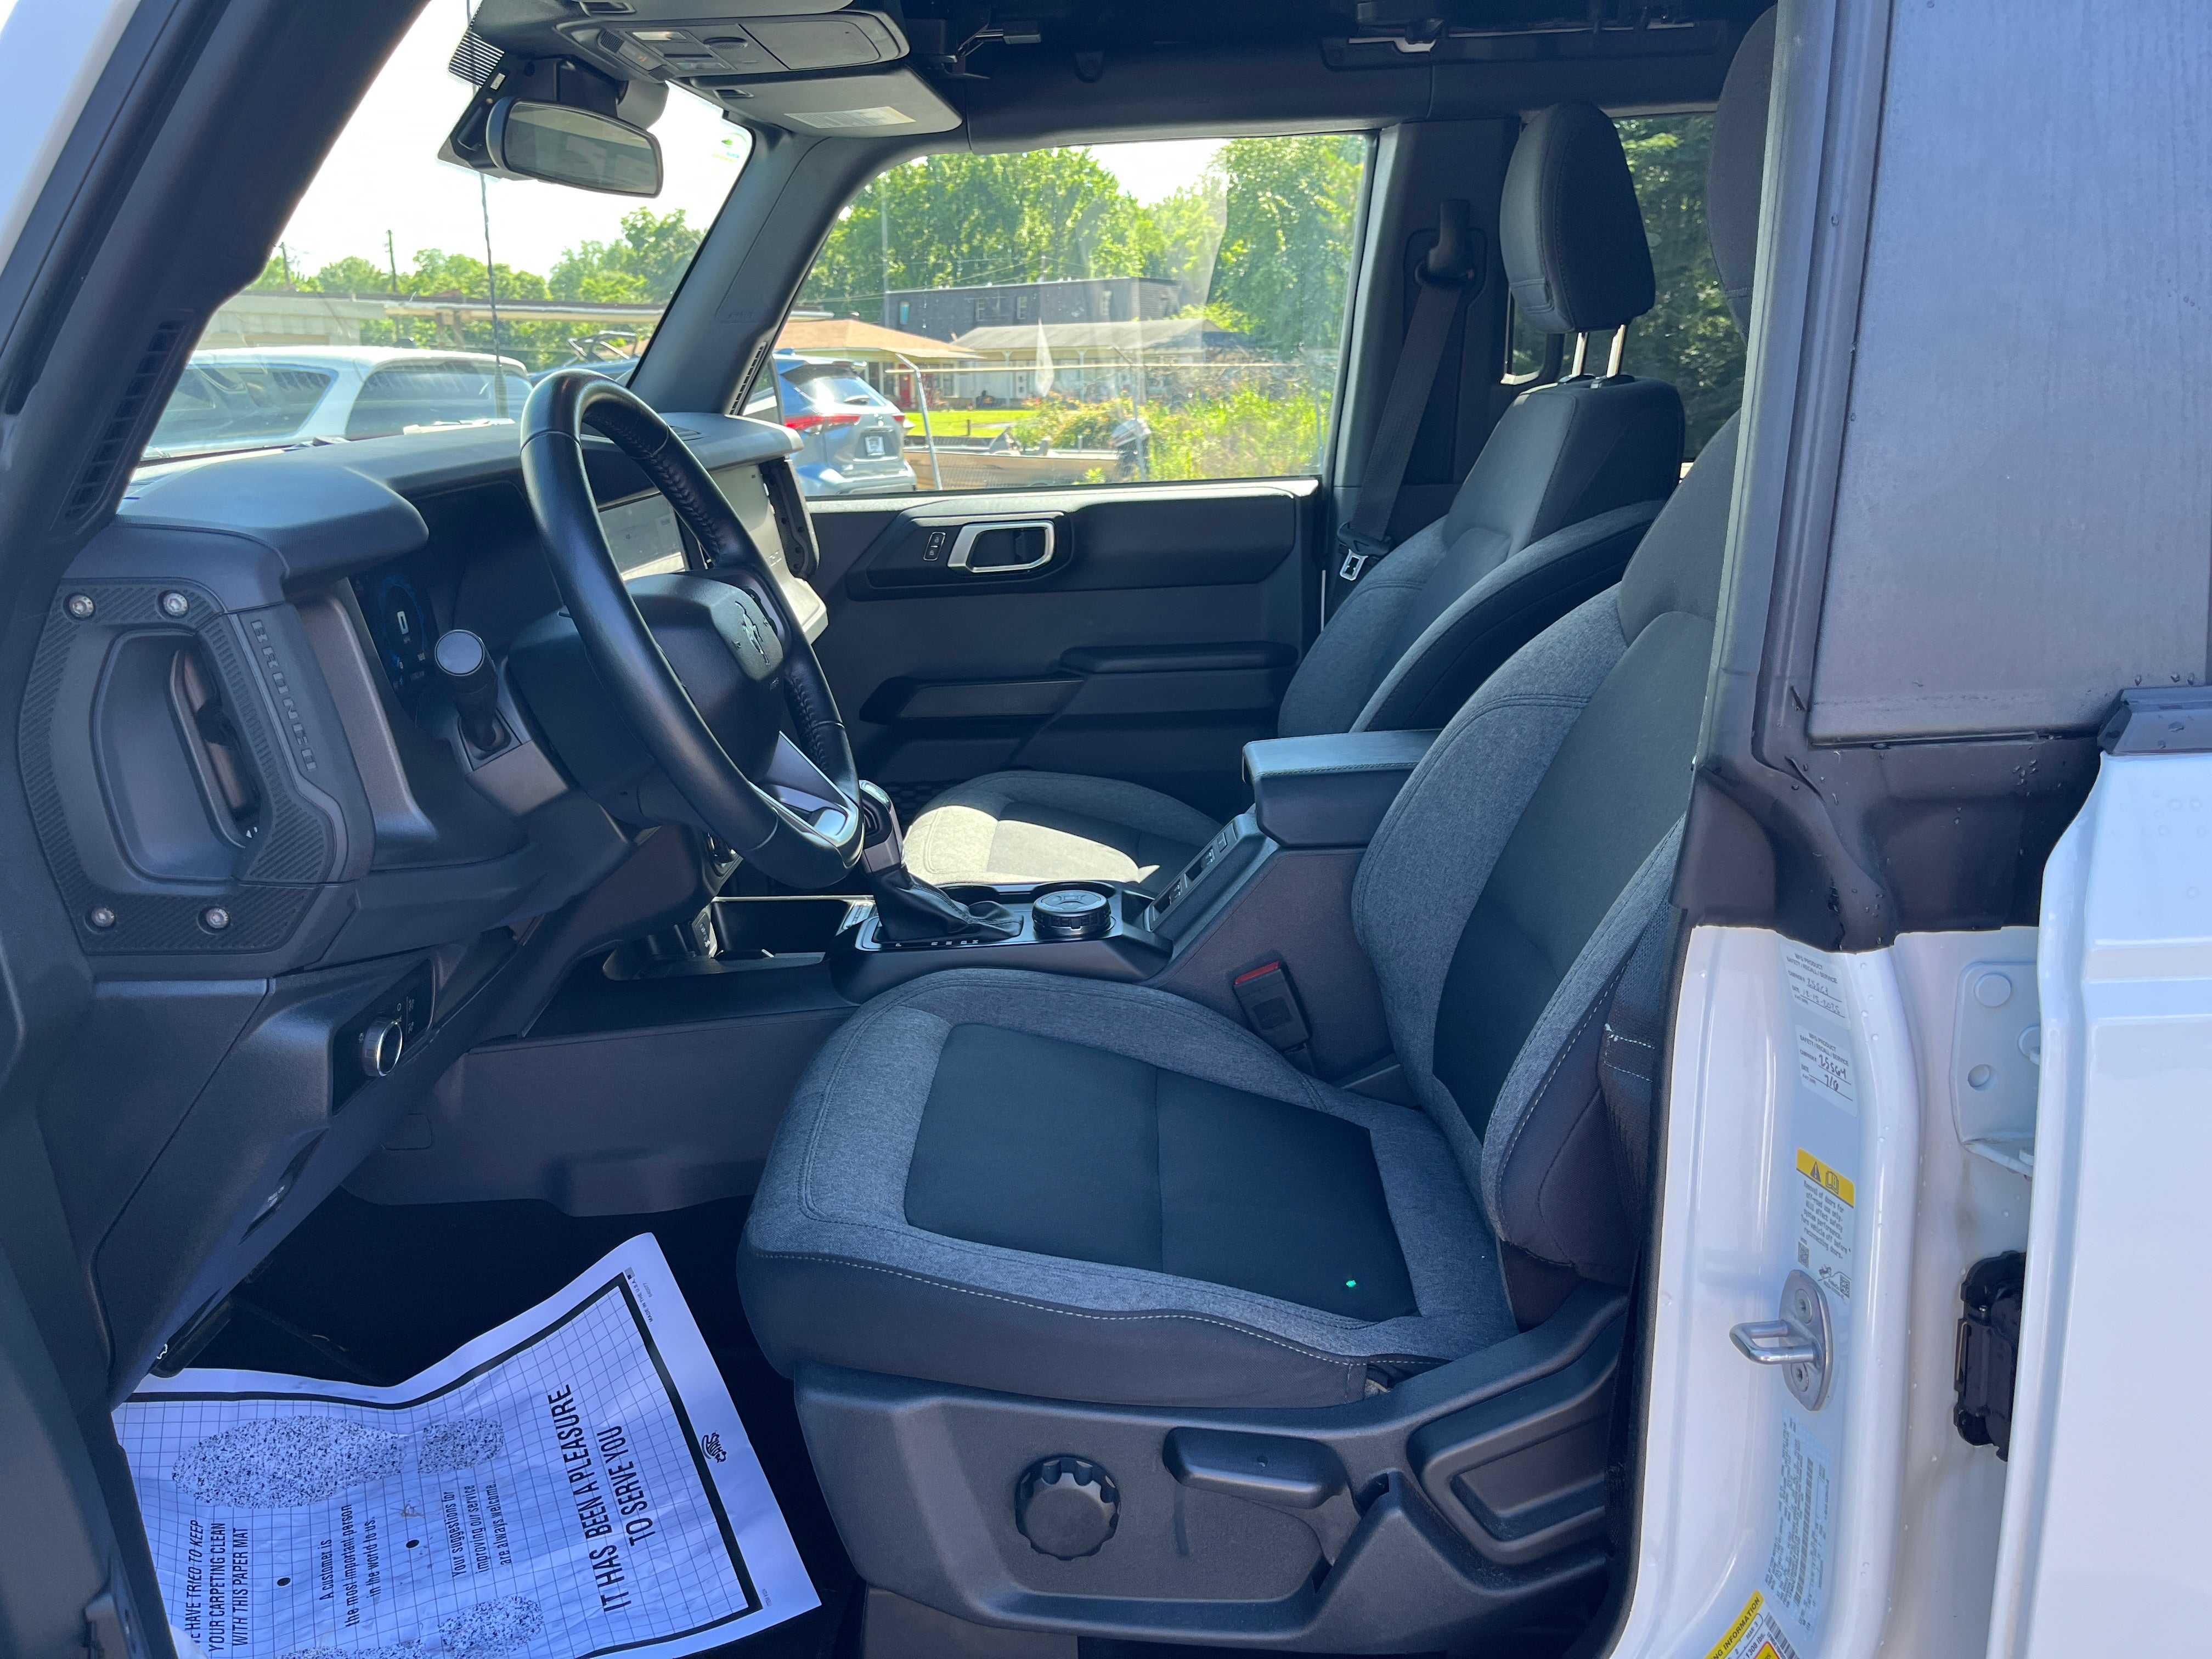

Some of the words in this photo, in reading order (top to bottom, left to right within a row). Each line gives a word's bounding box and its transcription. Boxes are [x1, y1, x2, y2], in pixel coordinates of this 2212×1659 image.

[251, 620, 317, 772] BRONCO
[1786, 956, 1800, 966] SAFETY
[1803, 963, 1818, 975] RECALL
[1820, 972, 1838, 984] SERVICE
[1804, 957, 1822, 970] PRODUCT
[1799, 1035, 1814, 1046] SAFETY
[1816, 1043, 1830, 1056] RECALL
[1832, 1053, 1849, 1066] SERVICE
[1818, 1037, 1836, 1052] PRODUCT
[1825, 1195, 1836, 1208] doors
[1810, 1223, 1825, 1237] vehicle
[1834, 1239, 1847, 1254] before
[1830, 1218, 1843, 1233] safety
[645, 1307, 653, 1322] MADE
[548, 1384, 597, 1483] PLEASURE
[597, 1426, 629, 1464] YOU
[442, 1492, 455, 1502] for
[462, 1485, 479, 1513] service
[486, 1481, 501, 1519] welcome.
[573, 1480, 600, 1496] A
[608, 1460, 648, 1516] SERVE
[341, 1505, 357, 1536] person
[364, 1517, 376, 1532] us.
[444, 1503, 465, 1554] suggestions
[469, 1515, 482, 1526] our
[578, 1495, 613, 1539] BEEN
[190, 1520, 204, 1547] KEEP
[211, 1523, 225, 1554] CLEAN
[233, 1528, 248, 1548] MAT
[318, 1539, 332, 1549] is
[363, 1533, 377, 1543] to
[493, 1519, 509, 1549] always
[625, 1517, 656, 1547] TO
[189, 1549, 202, 1562] TO
[341, 1537, 360, 1581] important
[362, 1544, 379, 1570] world
[470, 1527, 491, 1574] improving
[499, 1550, 512, 1565] are
[233, 1551, 248, 1585] PAPER
[319, 1551, 334, 1590] customer
[366, 1571, 381, 1585] the
[452, 1555, 466, 1577] Your
[589, 1544, 625, 1588] HAS
[187, 1567, 202, 1598] TRIED
[208, 1558, 225, 1617] CARPETING
[319, 1592, 334, 1600] A
[342, 1581, 358, 1606] most
[366, 1586, 381, 1598] in
[233, 1589, 248, 1612] THIS
[600, 1591, 631, 1612] IT
[185, 1602, 201, 1631] HAVE
[345, 1607, 360, 1627] the
[1723, 1596, 1760, 1650] INFORMATION
[208, 1620, 225, 1652] YOUR
[232, 1617, 248, 1646] WITH
[1746, 1642, 1758, 1658] 1308
[1756, 1633, 1765, 1644] lbs.
